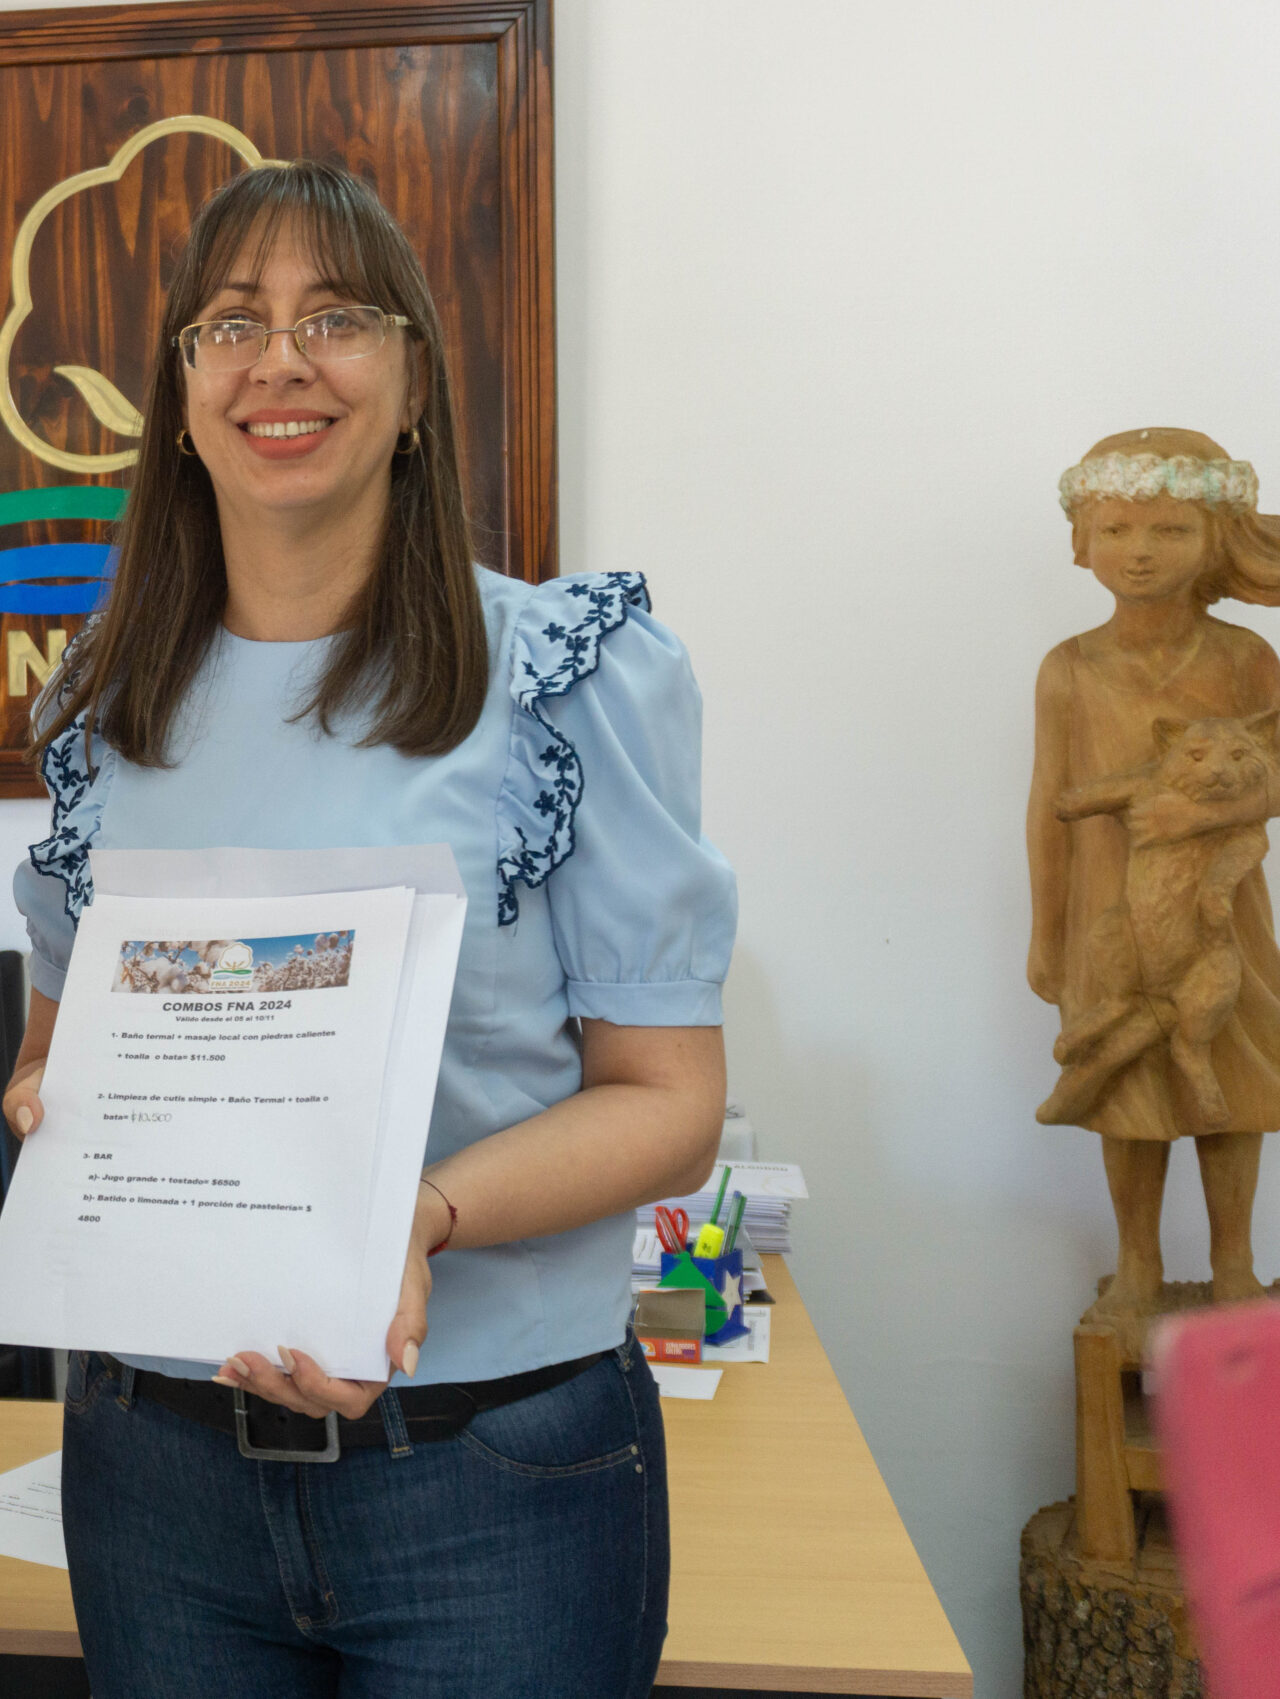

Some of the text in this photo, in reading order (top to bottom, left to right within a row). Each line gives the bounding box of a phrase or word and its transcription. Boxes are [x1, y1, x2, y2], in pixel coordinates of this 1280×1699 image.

[162, 1000, 292, 1012] COMBOS FNA 2024
[261, 1032, 293, 1041] piedras
[296, 1030, 336, 1039] calientes
[190, 1053, 226, 1061] $11.500
[108, 1093, 147, 1101] Limpieza
[188, 1096, 218, 1104] simple
[102, 1174, 124, 1182] Jugo
[97, 1194, 127, 1202] Batido
[137, 1196, 179, 1205] limonada
[198, 1199, 233, 1208] porción
